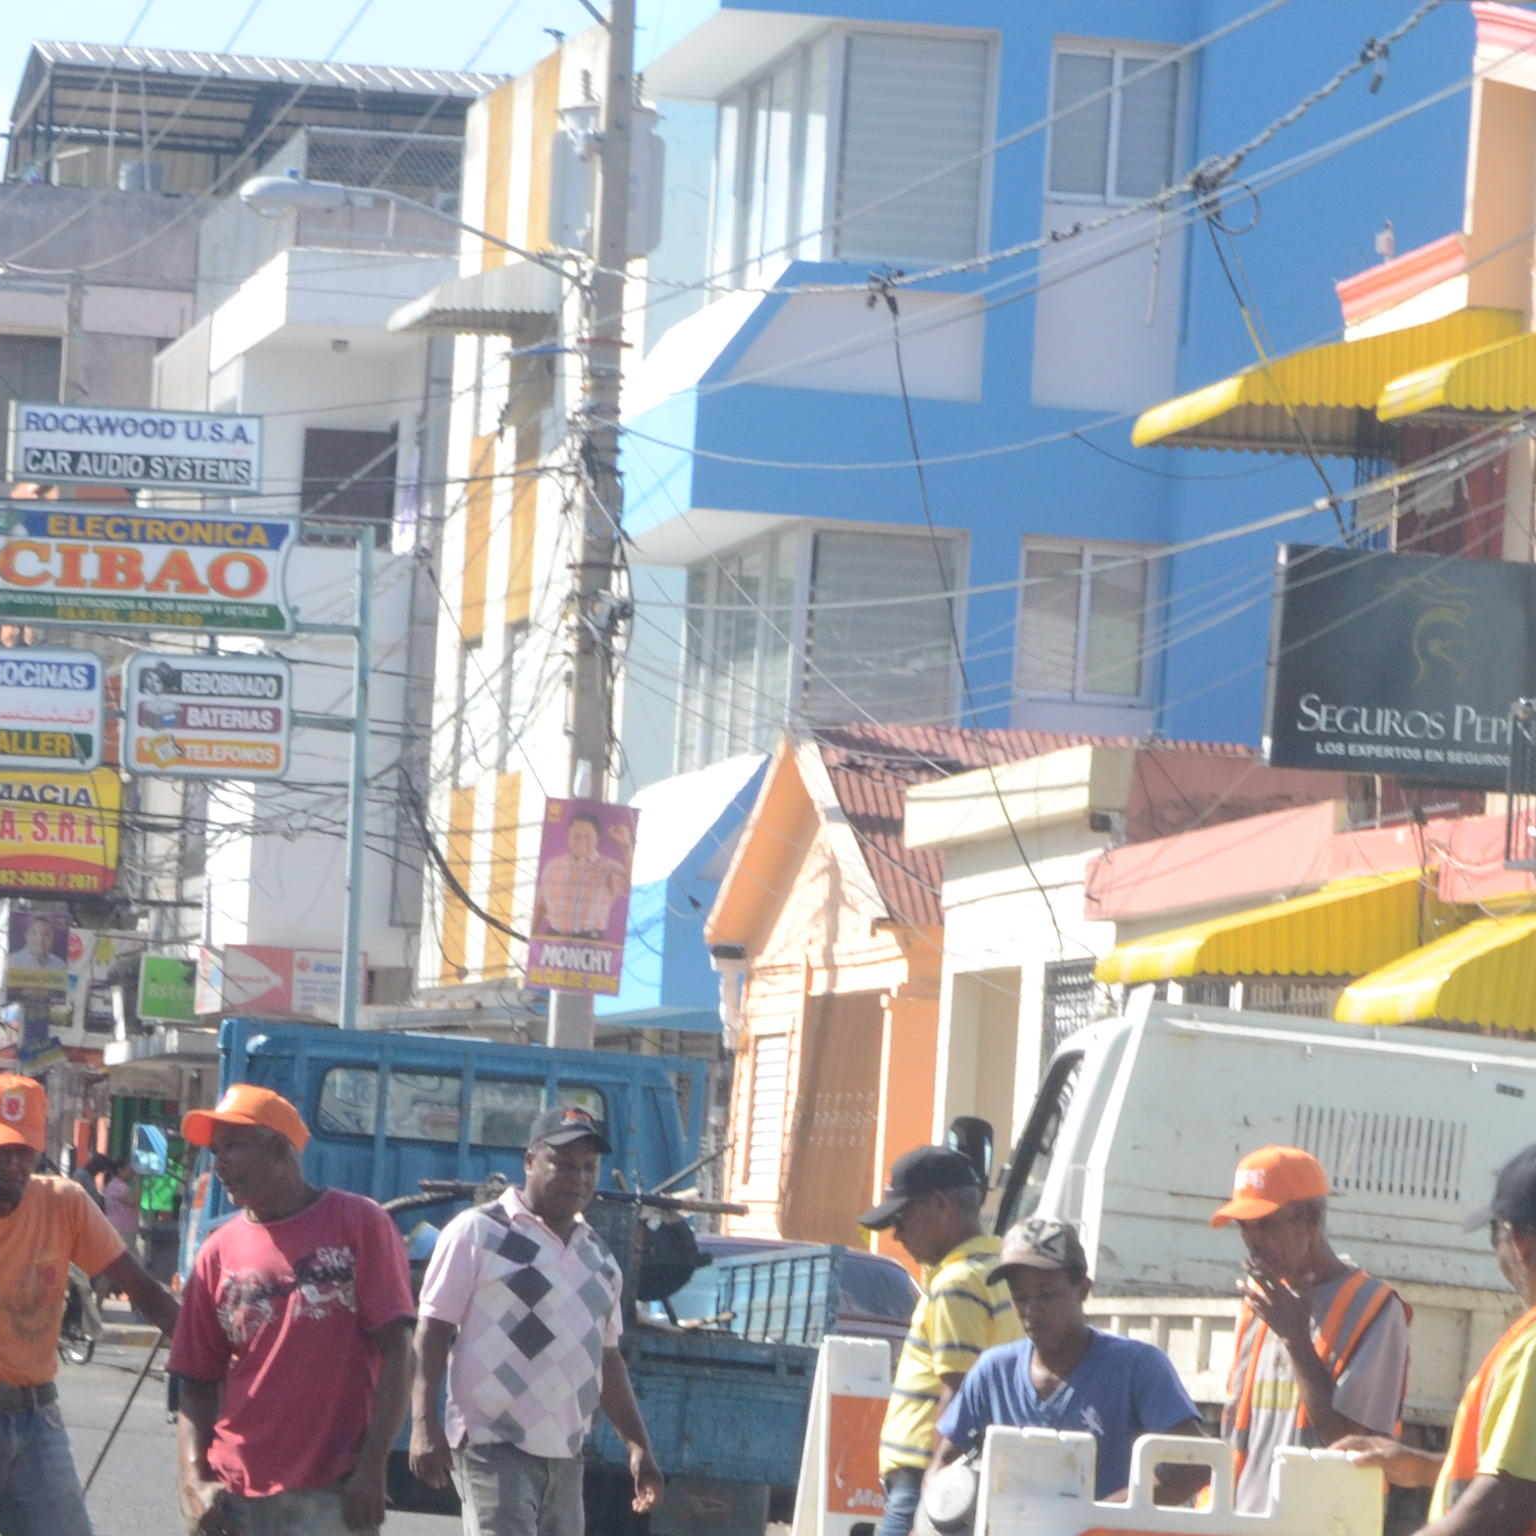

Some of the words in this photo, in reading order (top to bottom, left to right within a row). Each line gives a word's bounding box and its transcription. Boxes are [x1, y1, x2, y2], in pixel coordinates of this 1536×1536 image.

[25, 412, 176, 440] ROCKWOOD
[185, 421, 254, 444] U.S.A.
[25, 450, 72, 475] CAR
[76, 453, 145, 478] AUDIO
[150, 457, 252, 484] SYSTEMS
[47, 514, 269, 547] ELECTRONICA
[182, 674, 280, 699] REBOBINADO
[187, 711, 275, 731] BATERIAS
[1297, 693, 1446, 740] SEGUROS
[184, 745, 276, 766] TELEFONOS
[1316, 741, 1345, 755] LOS
[1348, 744, 1421, 761] EXPERTOS
[1424, 750, 1445, 762] EN
[539, 944, 613, 973] MONCHY
